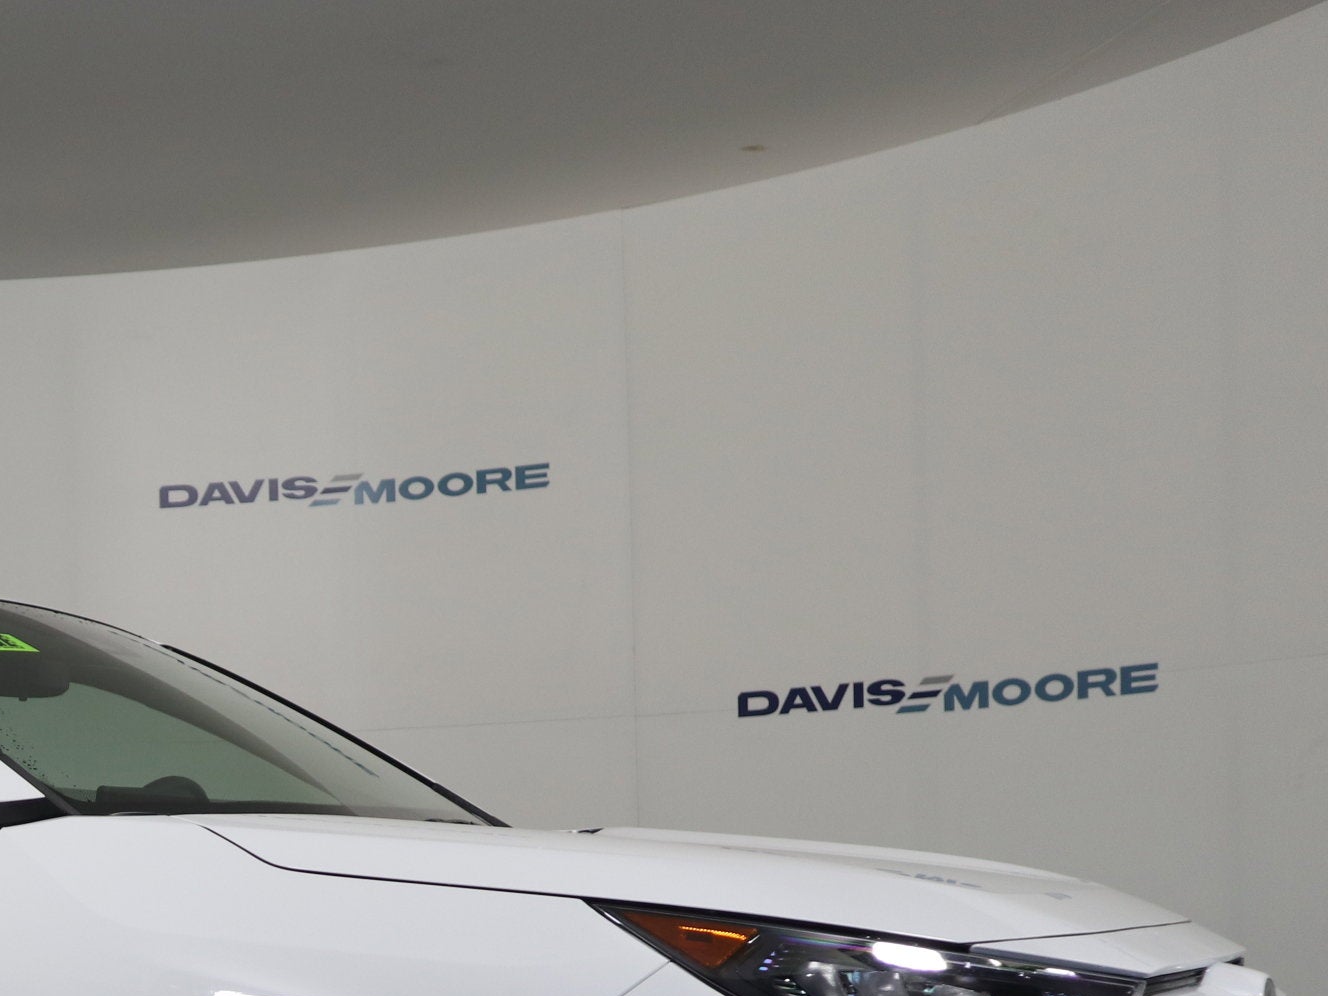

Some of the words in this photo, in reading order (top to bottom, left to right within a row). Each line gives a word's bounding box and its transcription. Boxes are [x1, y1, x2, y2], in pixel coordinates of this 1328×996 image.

[159, 476, 318, 508] DAVIS
[354, 462, 550, 505] MOORE
[737, 679, 905, 717] DAVIS
[943, 662, 1159, 712] MOORE
